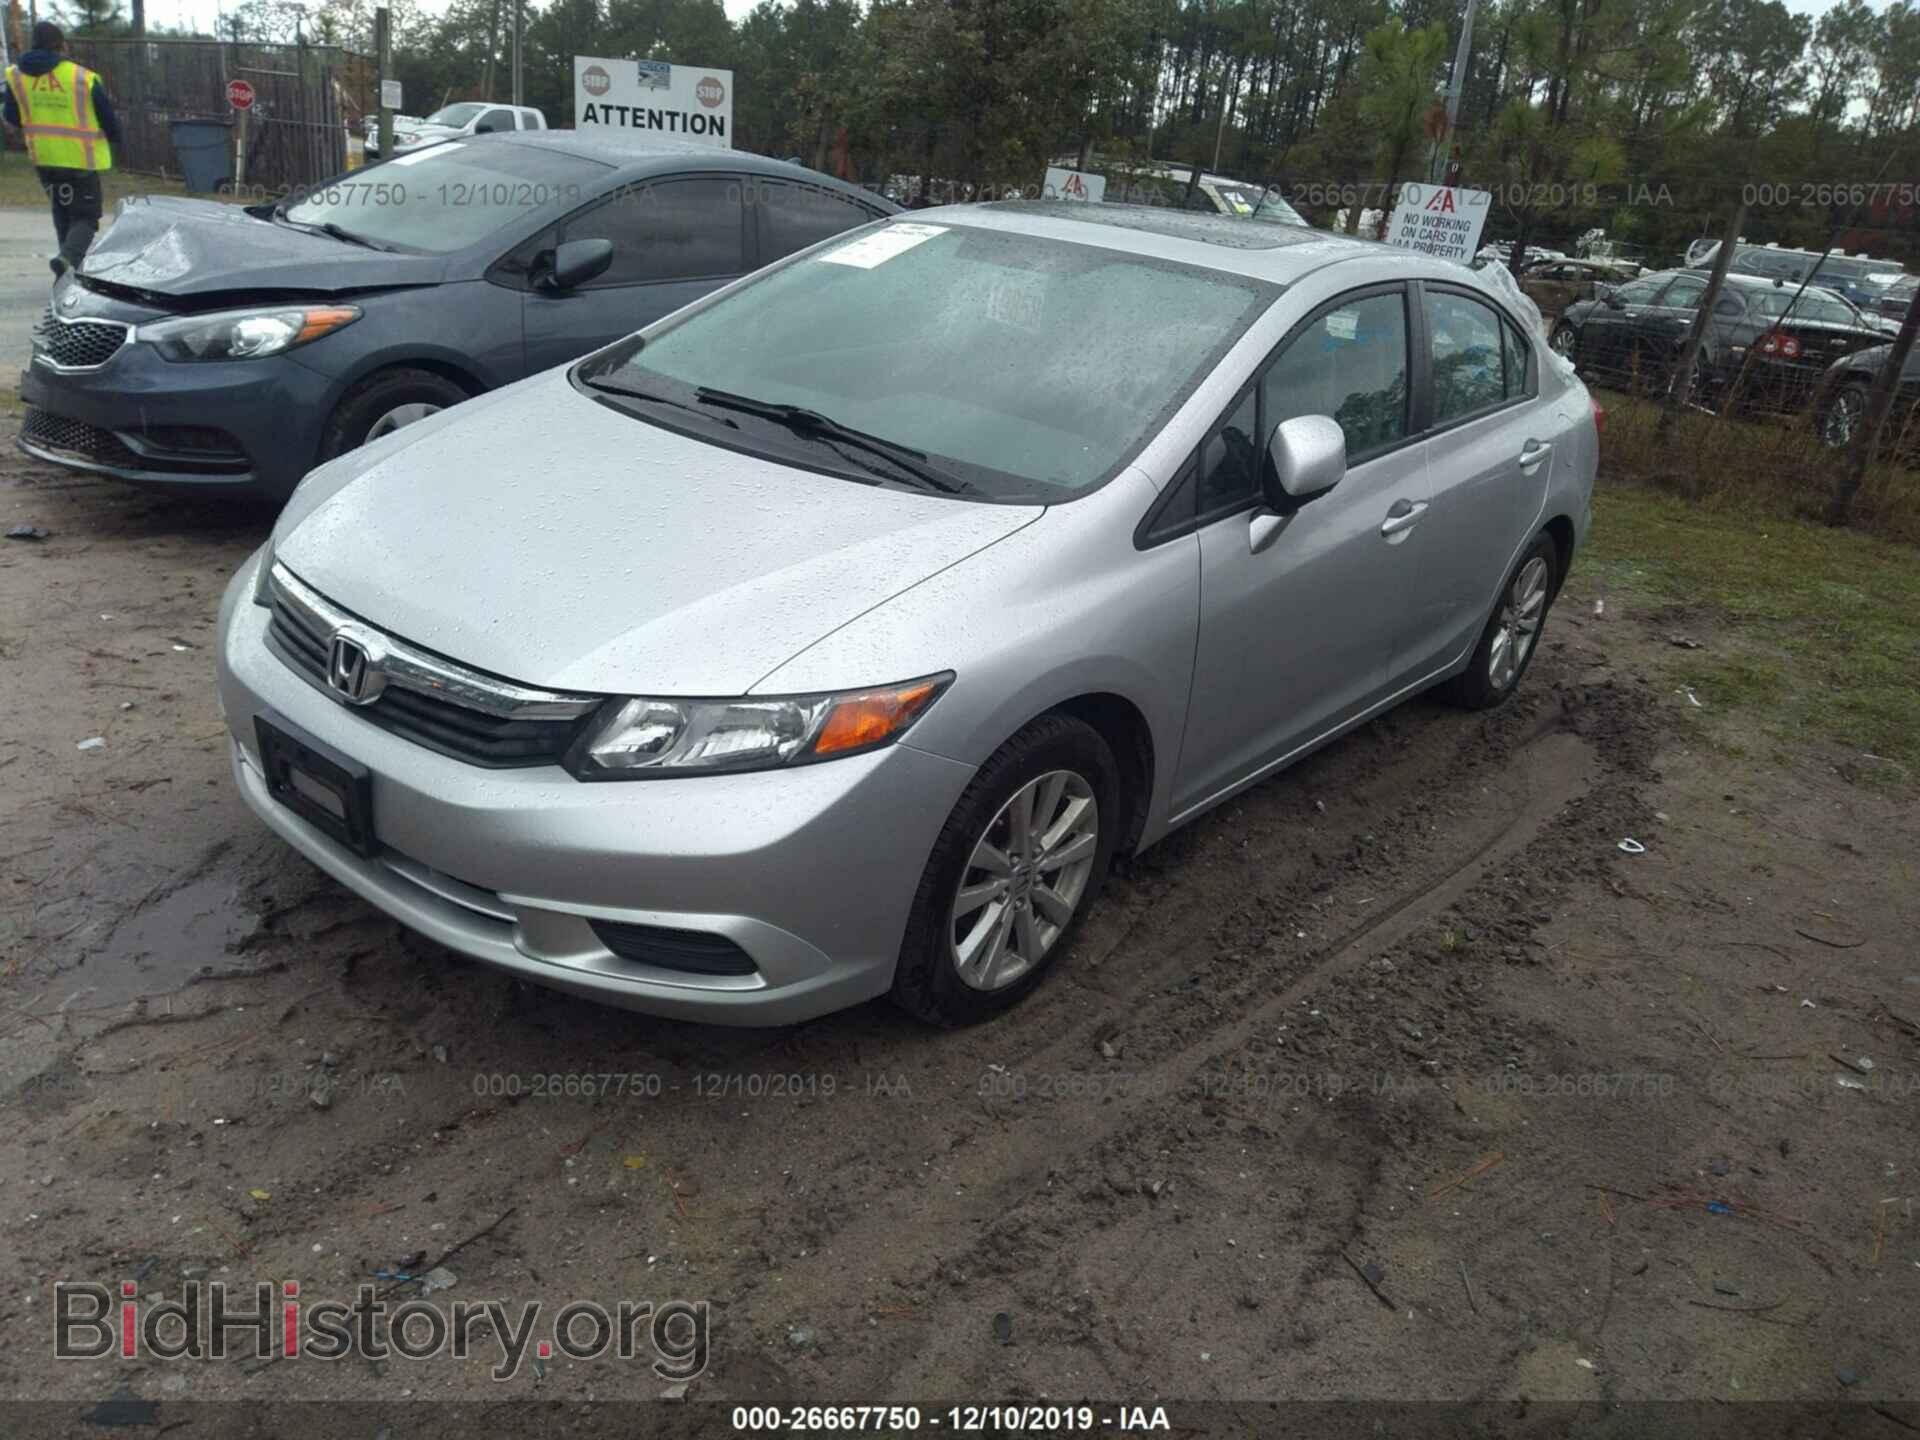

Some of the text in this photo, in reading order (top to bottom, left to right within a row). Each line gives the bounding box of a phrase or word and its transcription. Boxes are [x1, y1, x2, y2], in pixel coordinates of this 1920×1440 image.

[584, 75, 609, 88] STOP
[227, 87, 253, 99] STOP
[700, 86, 723, 99] STOP
[582, 102, 725, 137] ATTENTION
[1403, 213, 1471, 232] NO WORKING
[1400, 226, 1466, 245] ON CARS ON
[1413, 241, 1467, 259] PROPERTY
